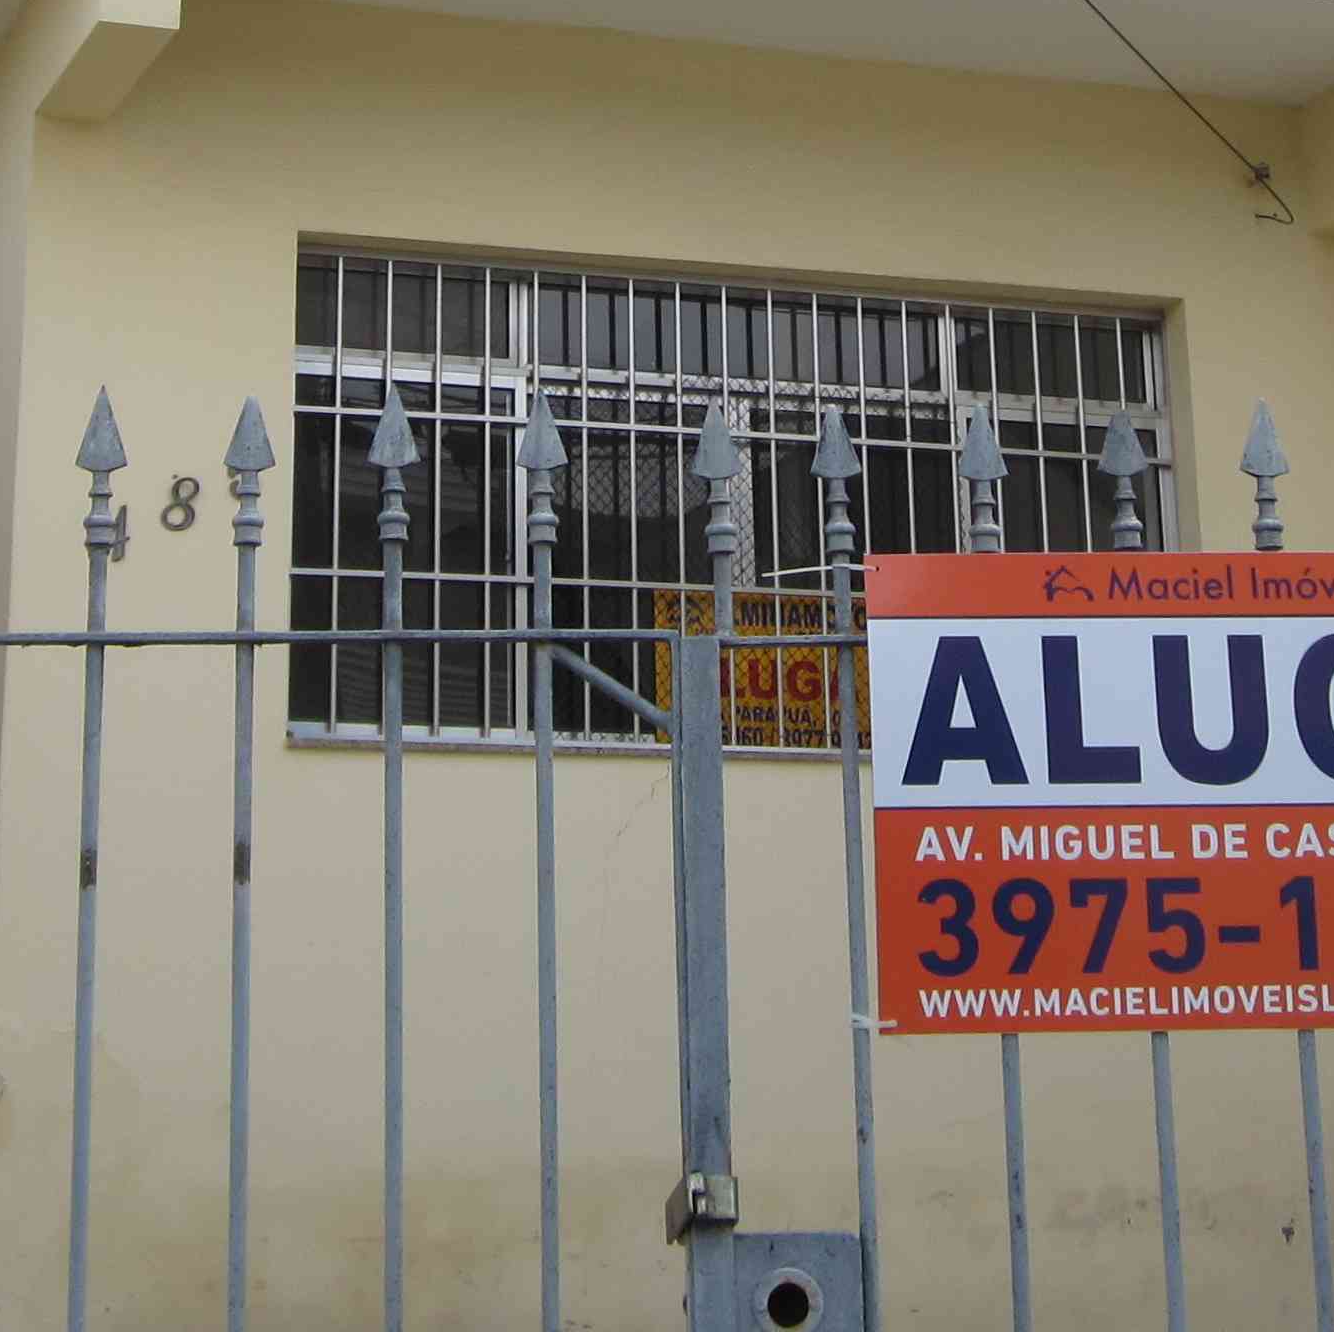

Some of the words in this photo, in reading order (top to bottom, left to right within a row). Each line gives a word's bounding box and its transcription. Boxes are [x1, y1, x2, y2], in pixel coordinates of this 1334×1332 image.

[1107, 565, 1234, 601] Maciel
[915, 826, 982, 862] AV.
[1000, 825, 1175, 862] MIGUEL
[1191, 823, 1249, 859] DE
